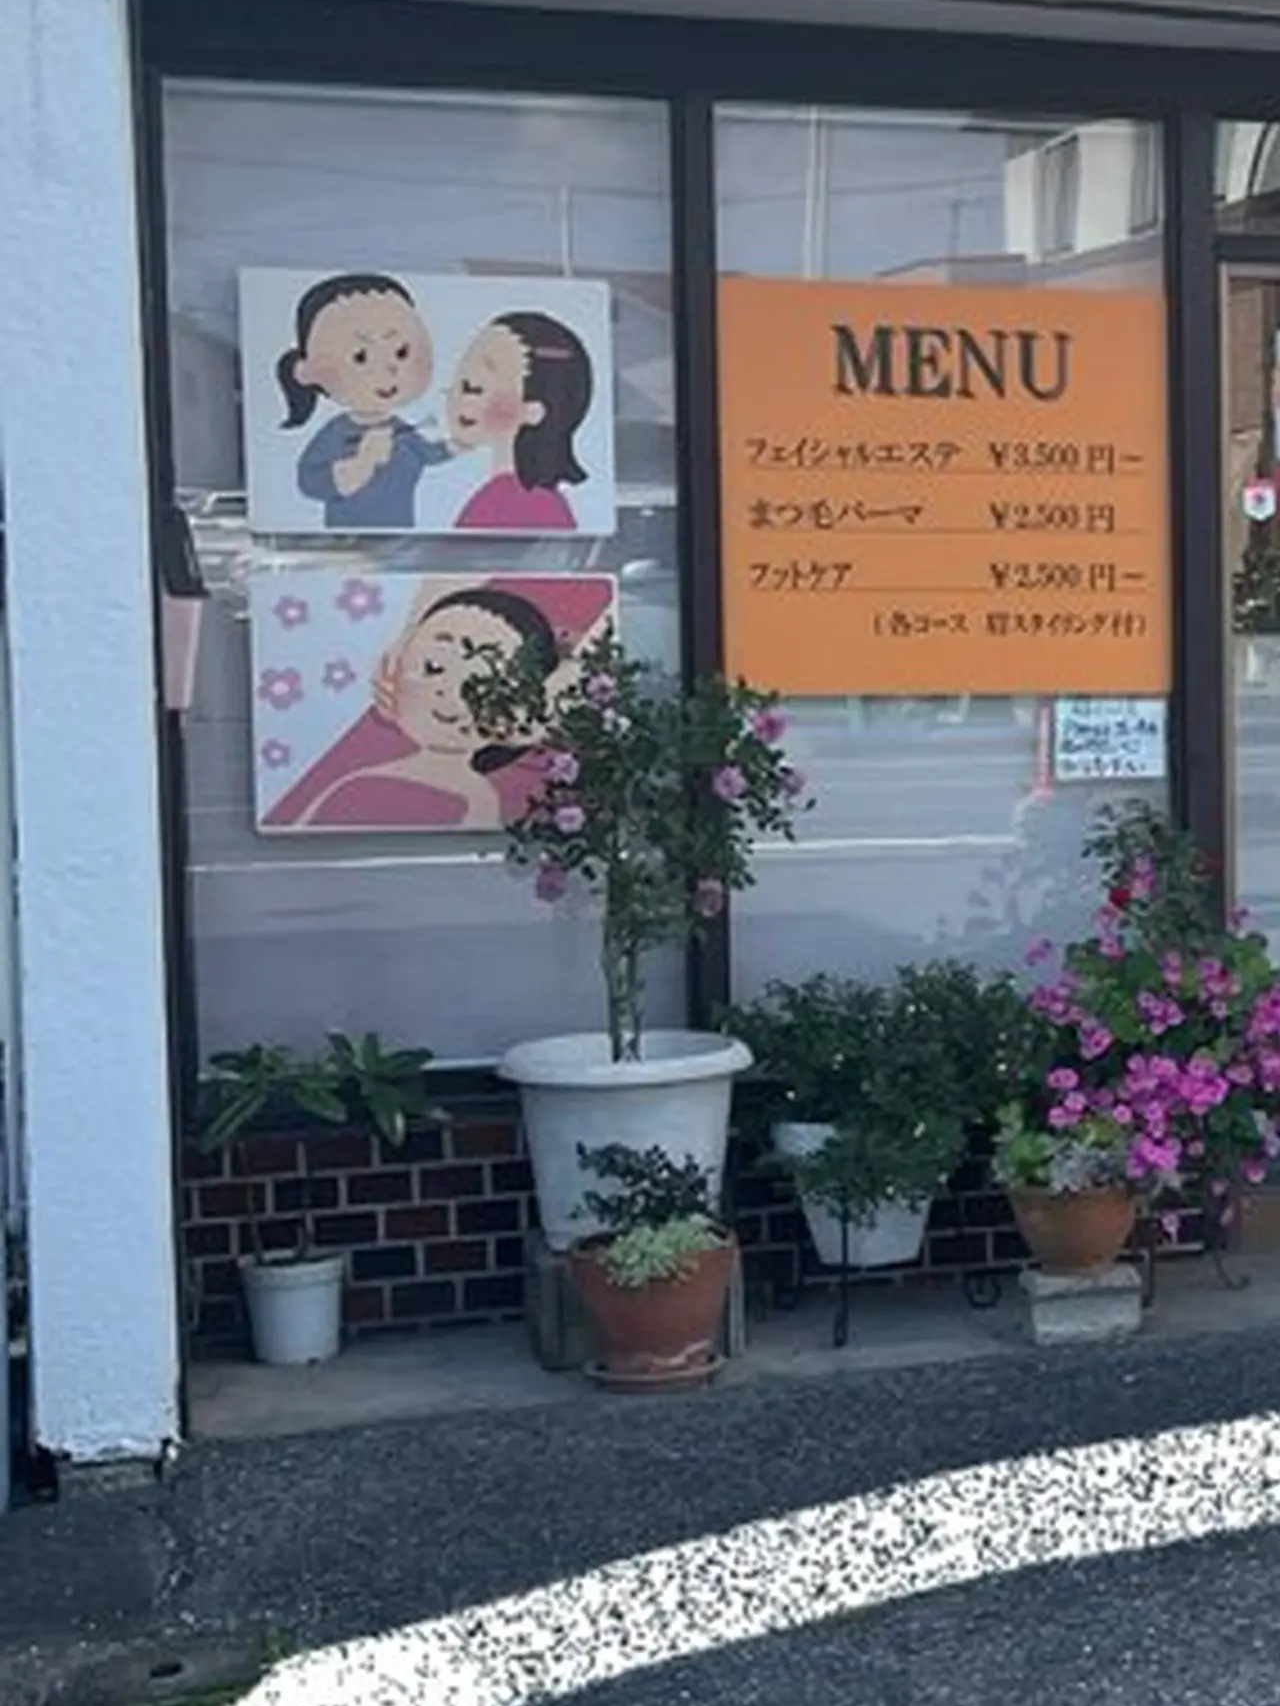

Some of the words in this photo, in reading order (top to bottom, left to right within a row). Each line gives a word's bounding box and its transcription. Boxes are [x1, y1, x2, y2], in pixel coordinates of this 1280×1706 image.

[830, 324, 1073, 401] MENU
[745, 436, 962, 471] フェイシャルエステ
[748, 498, 924, 531] まつ毛パーマ
[749, 559, 853, 592] フットケア
